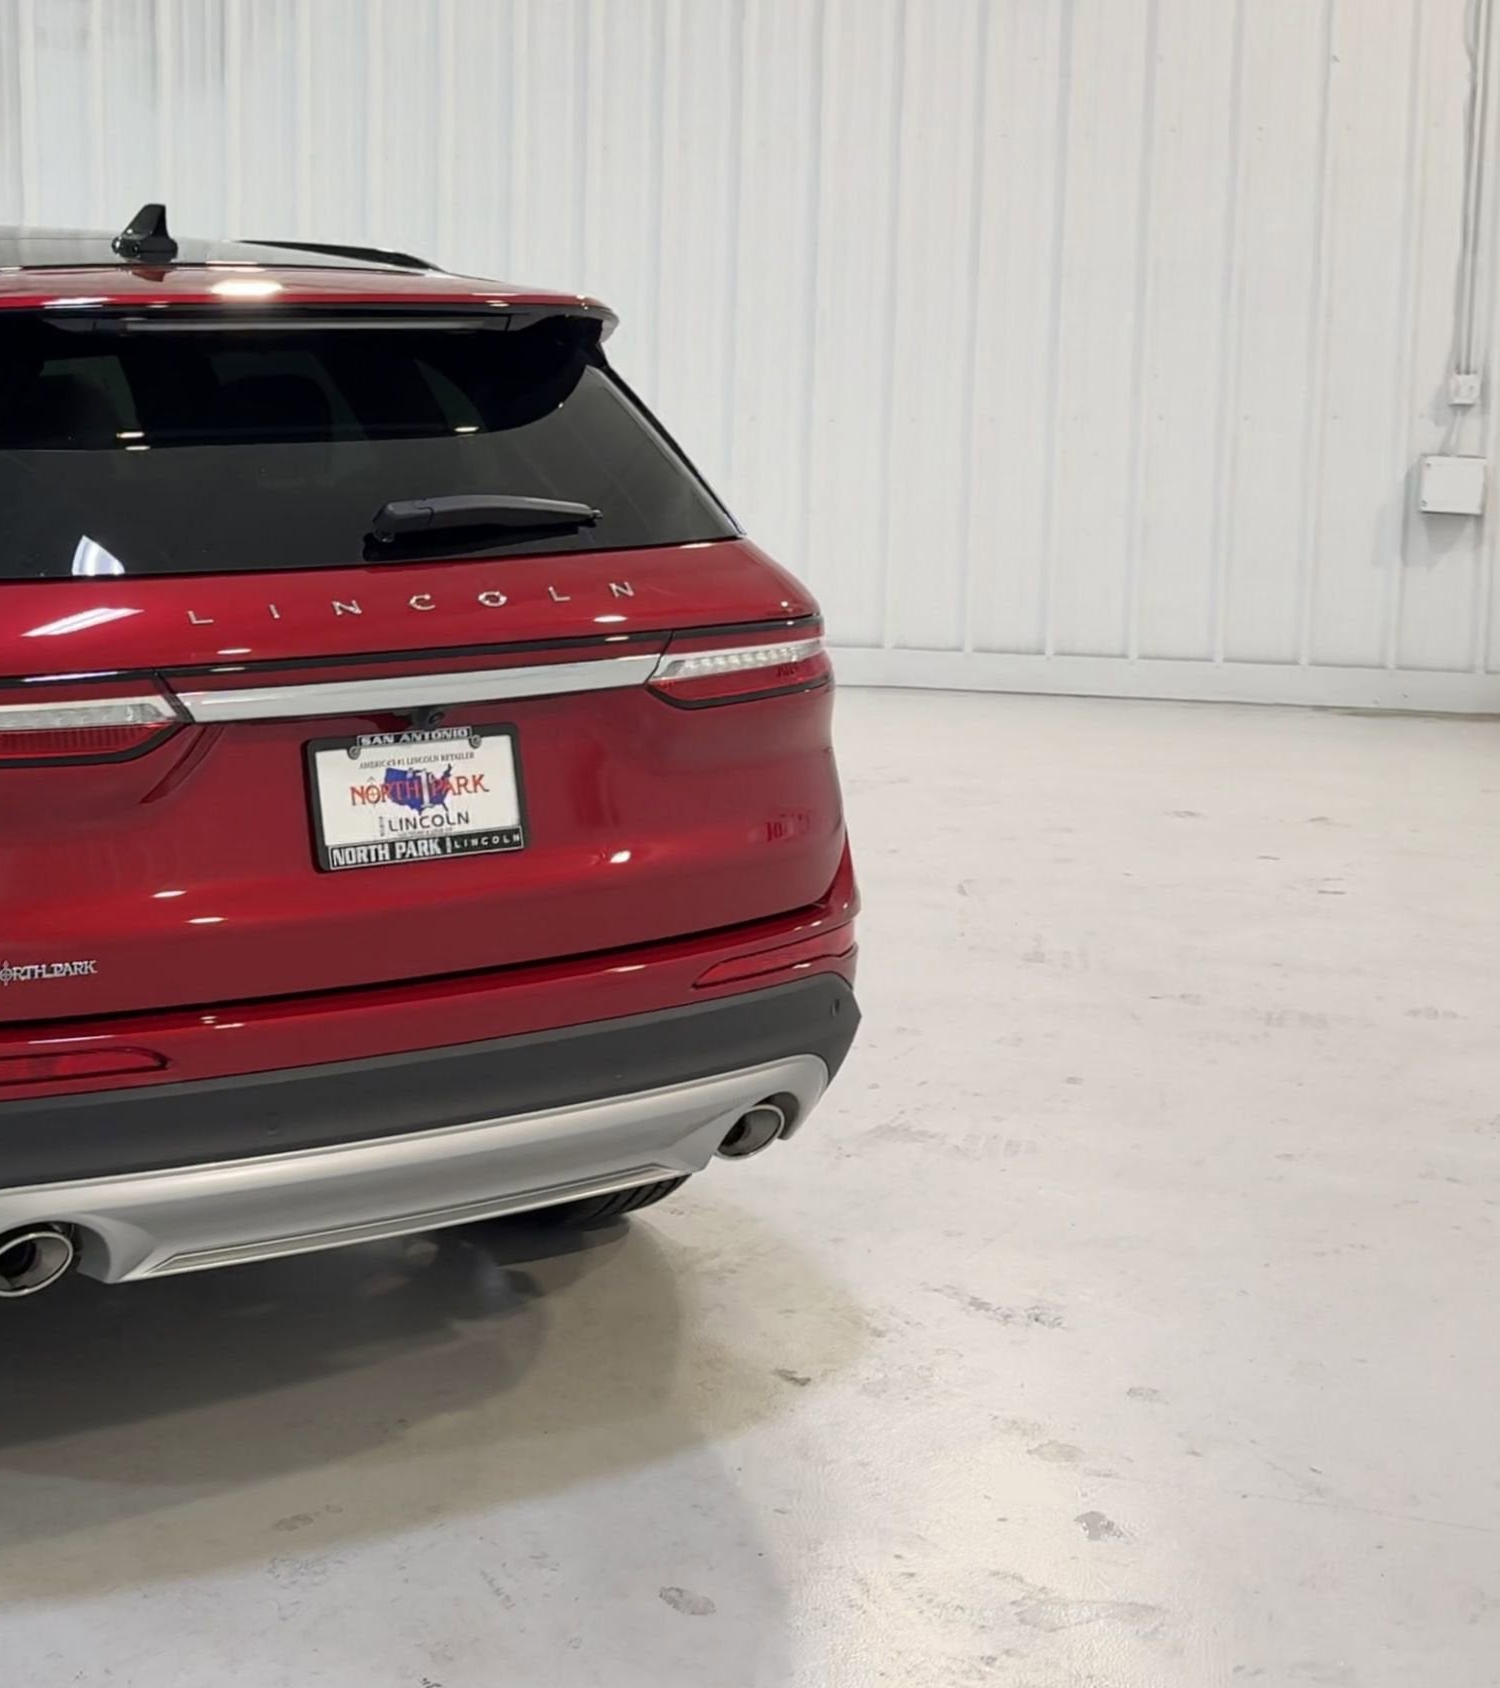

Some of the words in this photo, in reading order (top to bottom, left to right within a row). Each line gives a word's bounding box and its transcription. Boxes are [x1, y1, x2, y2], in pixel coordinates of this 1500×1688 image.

[187, 580, 635, 626] LINCOLN
[360, 734, 395, 746] SAN
[400, 727, 469, 743] ANTONIO
[406, 754, 440, 766] LINCOLN
[441, 751, 475, 762] RETAILER
[350, 779, 420, 807] NORTH
[429, 773, 490, 801] PARK
[388, 811, 470, 833] LINCOLN
[332, 842, 391, 868] NORTH
[395, 837, 442, 860] PARK
[454, 833, 521, 850] LINCOLN
[51, 960, 98, 978] PARK
